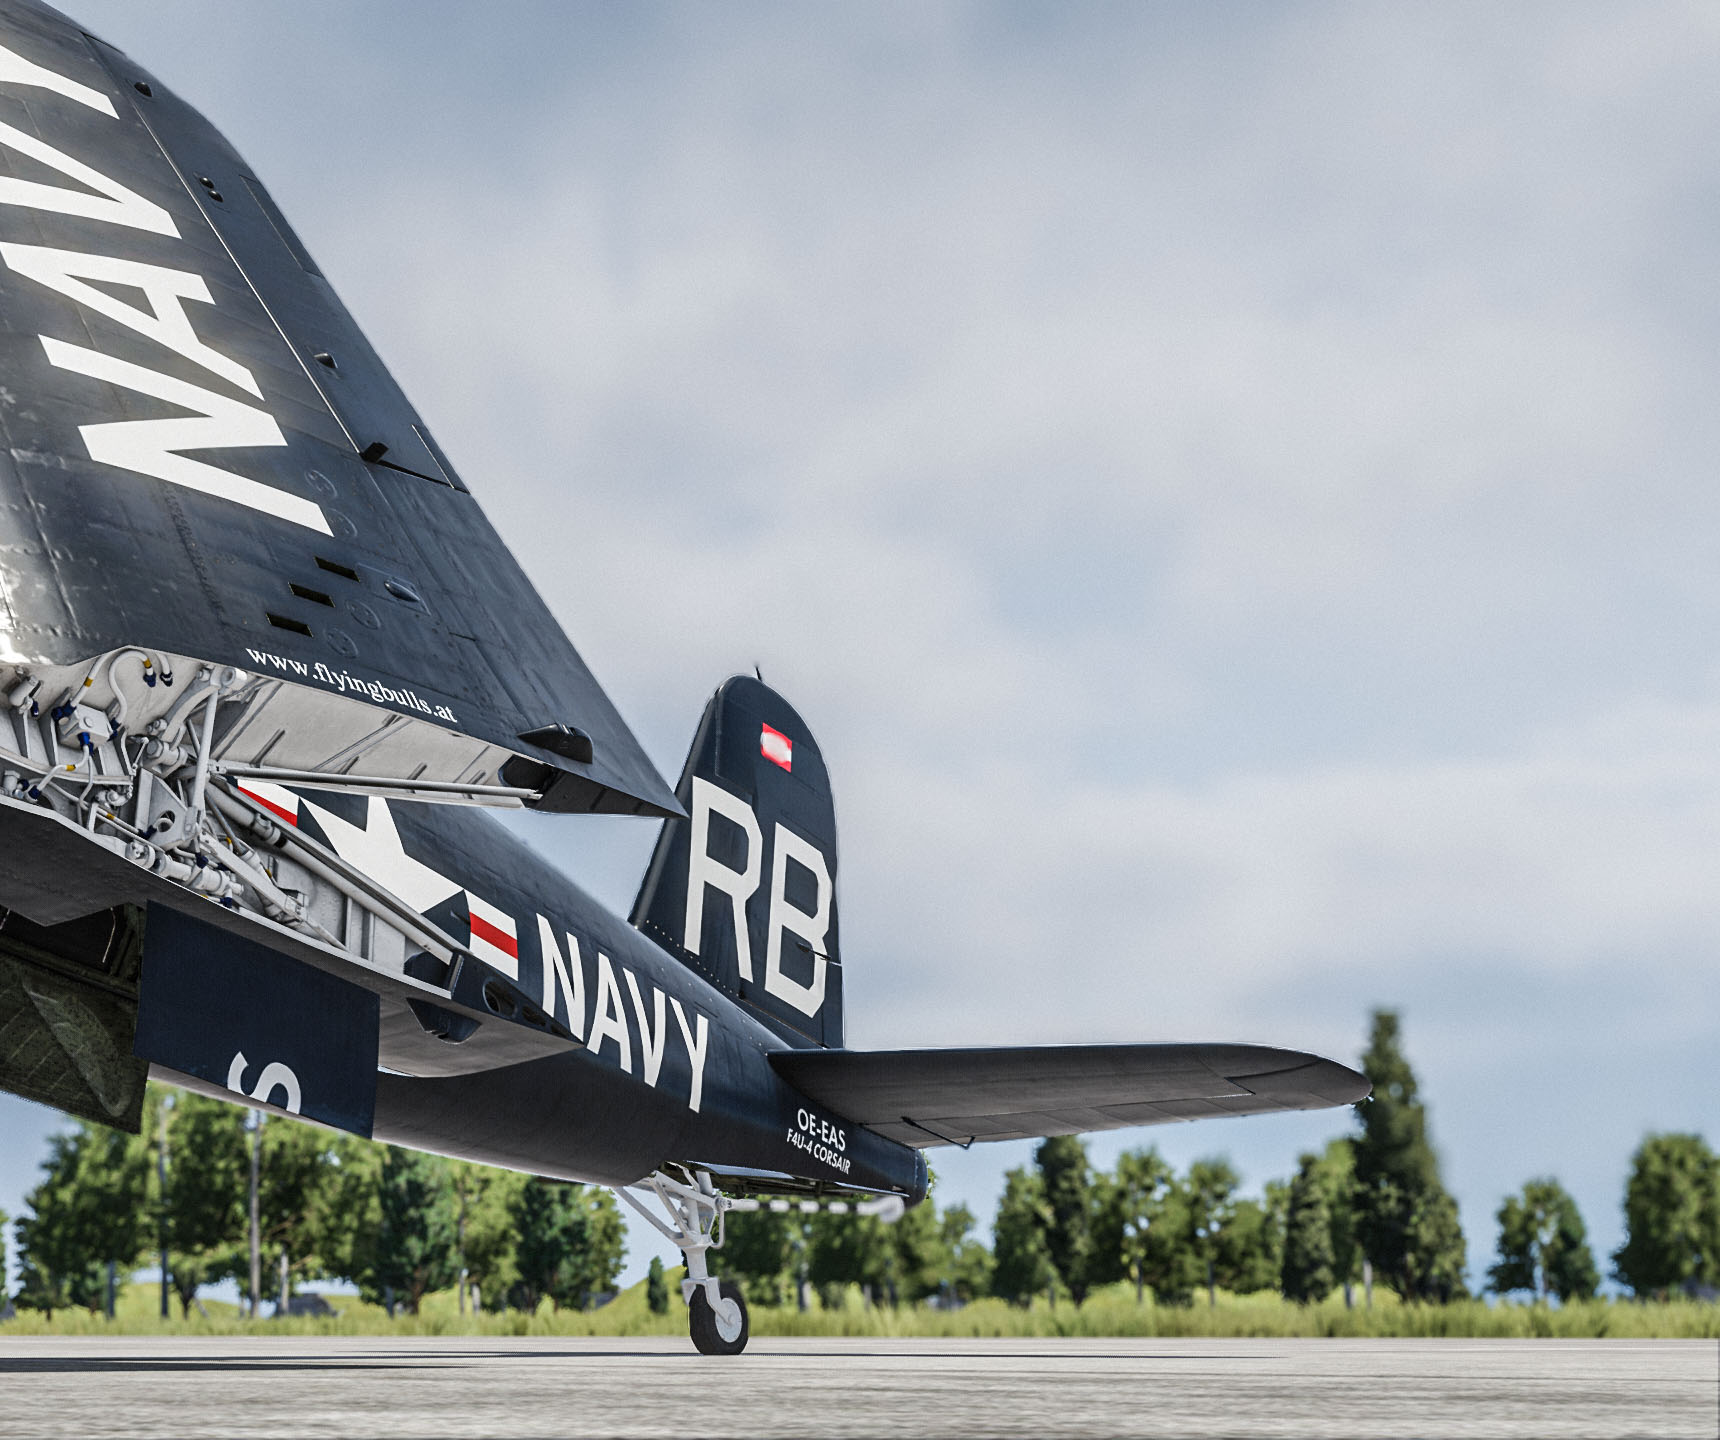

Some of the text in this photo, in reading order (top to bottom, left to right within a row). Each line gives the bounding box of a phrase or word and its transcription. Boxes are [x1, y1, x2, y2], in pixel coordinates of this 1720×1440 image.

[245, 648, 458, 723] www.flyingbulls.at
[683, 776, 833, 1019] RB
[536, 912, 709, 1114] NAVY
[786, 1128, 851, 1175] F4U-4 CORSAIR
[797, 1108, 846, 1152] OE-EAS
